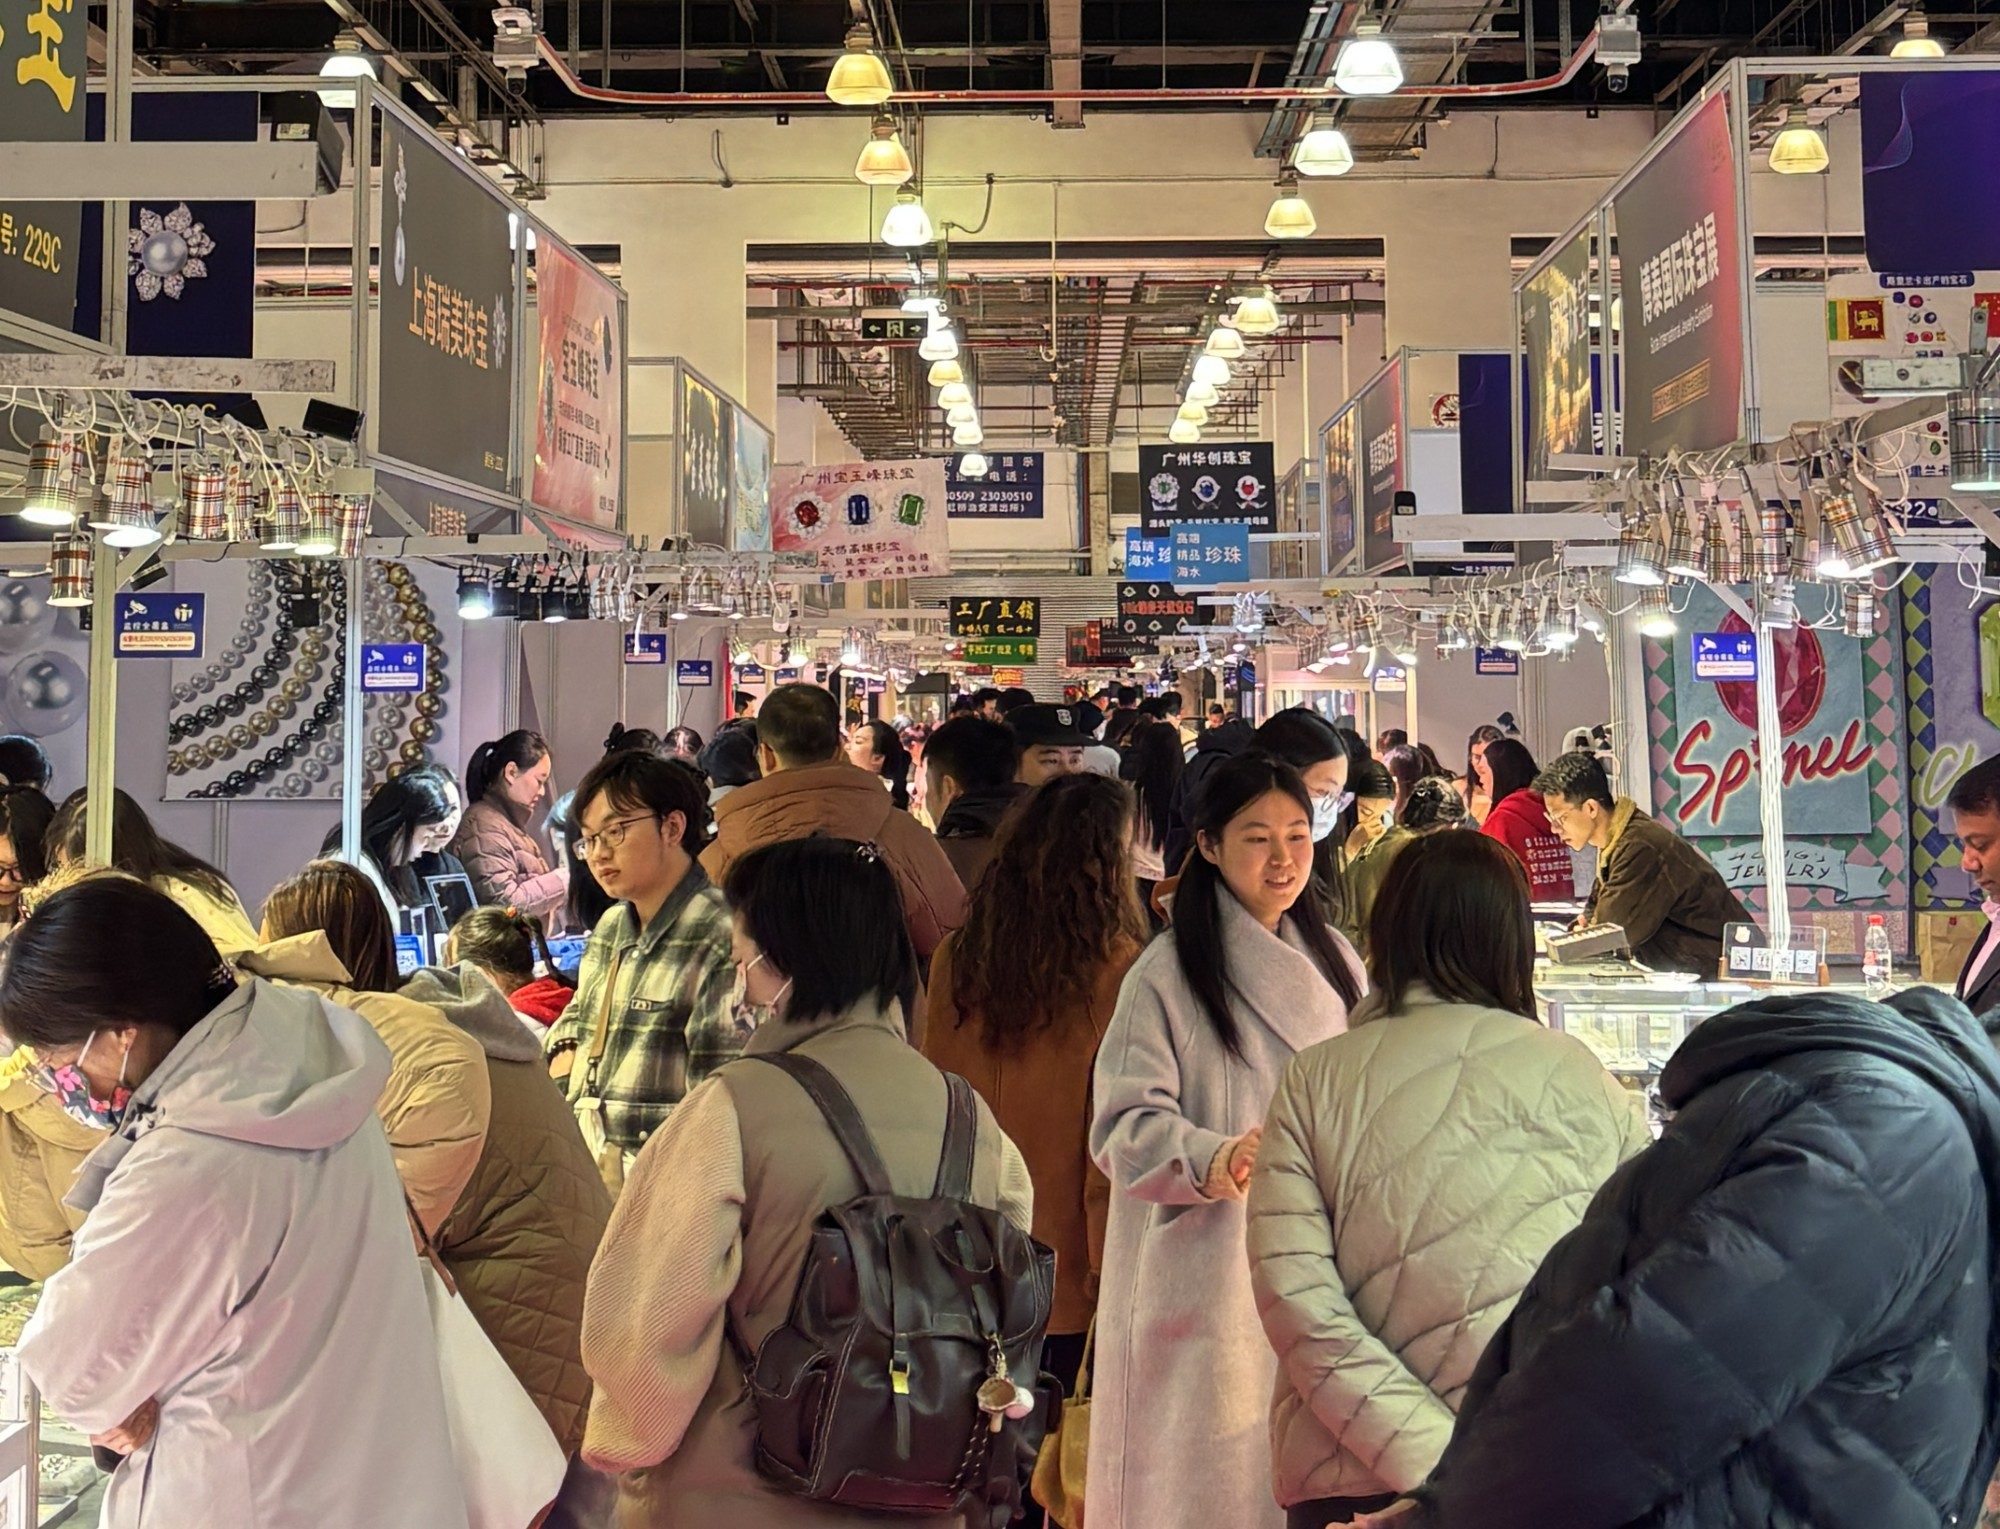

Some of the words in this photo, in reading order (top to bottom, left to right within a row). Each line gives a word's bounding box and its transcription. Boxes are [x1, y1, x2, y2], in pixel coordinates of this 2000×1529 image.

[24, 224, 62, 273] 229C
[1640, 212, 1719, 327] 博泰国际珠宝展
[1886, 275, 1968, 287] 斯里兰卡出产的宝石
[409, 266, 488, 369] 上海瑞美珠宝
[562, 335, 599, 399] 宝玉峰珠宝
[1162, 450, 1253, 467] 广州华创珠宝
[800, 467, 916, 485] 广州宝玉峰珠宝
[945, 491, 975, 501] 0509
[981, 491, 1033, 501] 23030510
[1205, 546, 1242, 564] 珍珠
[956, 600, 1034, 620] 工厂直销
[1673, 719, 1875, 827] Spnel
[1726, 863, 1831, 882] JEWLRY
